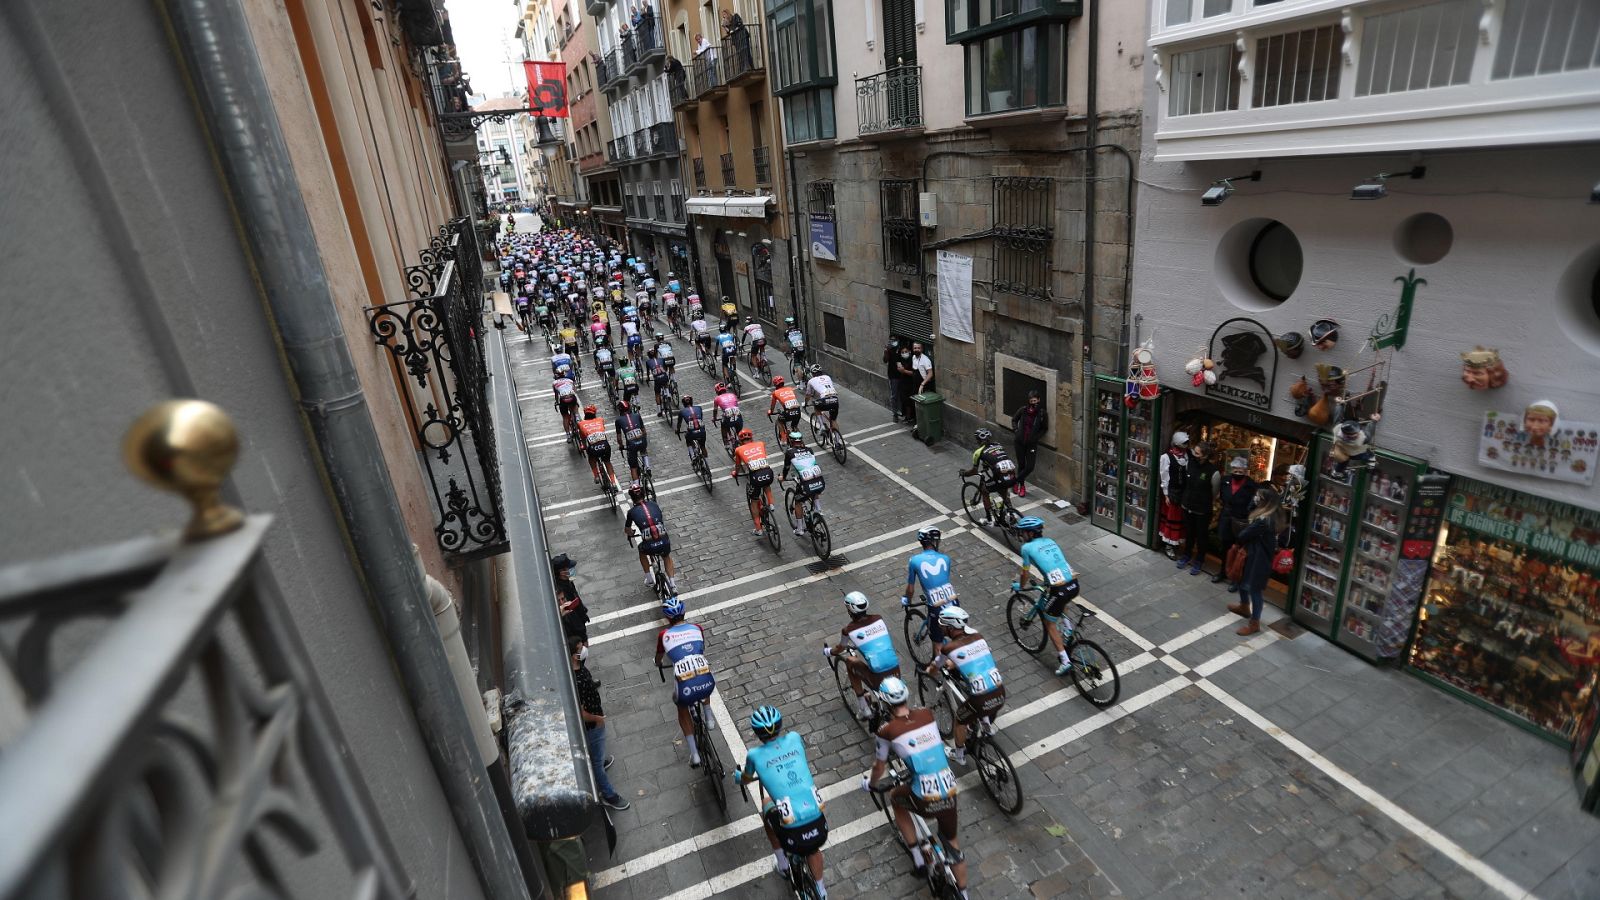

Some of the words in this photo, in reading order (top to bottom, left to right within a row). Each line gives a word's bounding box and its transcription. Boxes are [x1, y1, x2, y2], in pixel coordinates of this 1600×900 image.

[1465, 513, 1515, 542] GIGANTES
[1515, 524, 1530, 545] DE
[677, 660, 691, 674] 191
[692, 681, 713, 692] TOTAL
[766, 749, 800, 768] ASTANA
[921, 778, 940, 794] 124
[802, 828, 819, 840] KAZ
